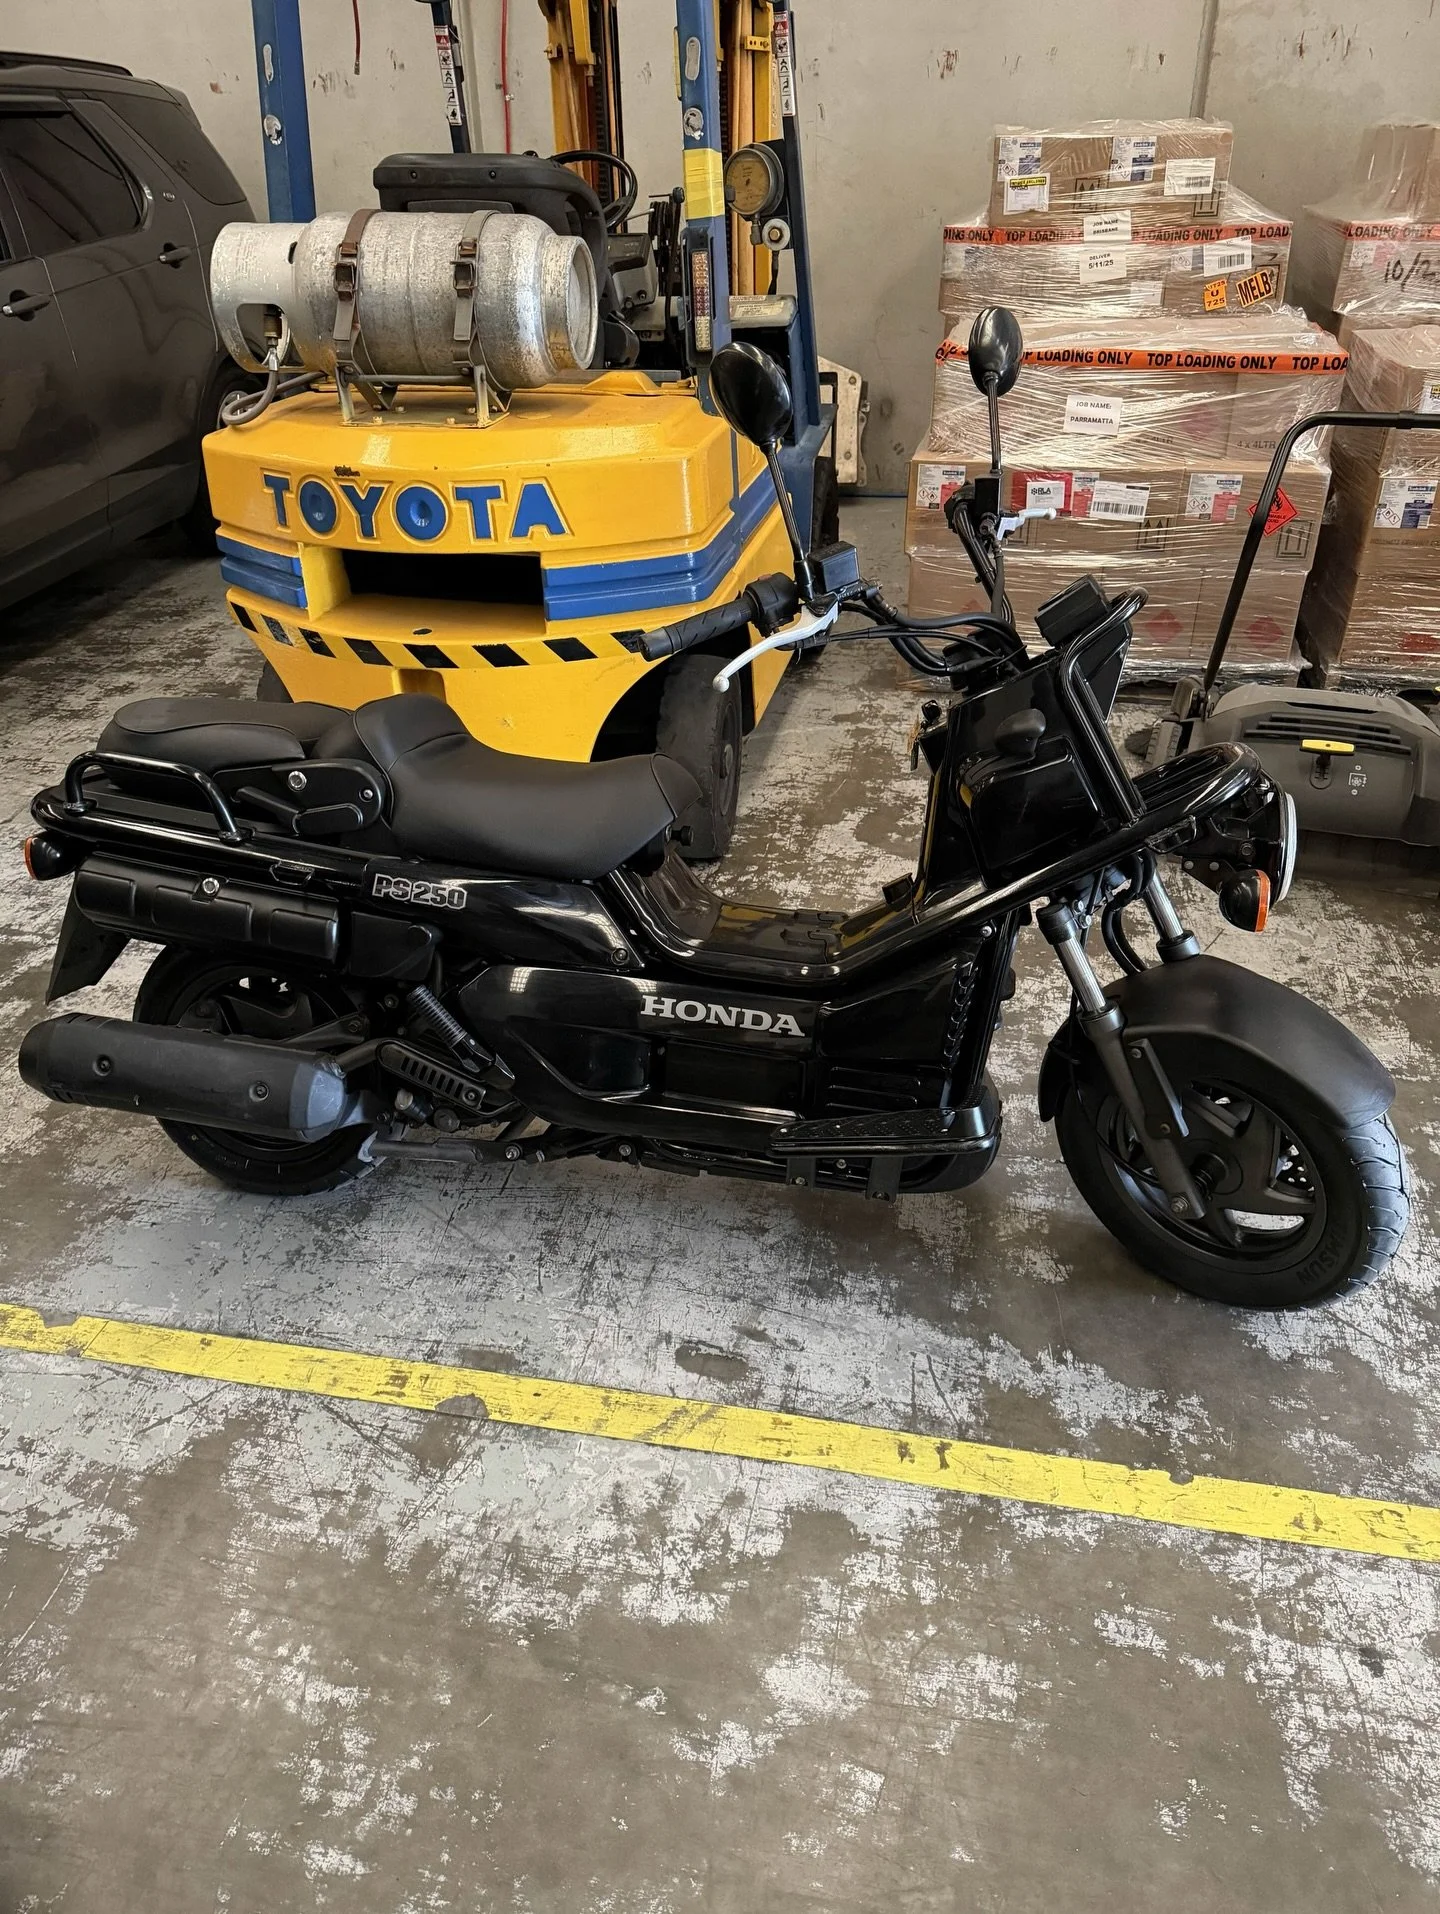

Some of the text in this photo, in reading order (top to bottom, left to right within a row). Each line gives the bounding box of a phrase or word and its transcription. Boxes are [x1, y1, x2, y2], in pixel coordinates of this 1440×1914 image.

[968, 229, 994, 241] ONLY
[1005, 230, 1026, 241] TOP
[1092, 226, 1119, 235] BRISBANE
[1193, 228, 1223, 241] ONLY
[1234, 228, 1258, 238] TOP
[1089, 253, 1111, 261] DELIVER
[1088, 259, 1114, 269] 5/11/25
[1211, 289, 1219, 297] U
[1238, 271, 1272, 306] MELB
[1206, 297, 1225, 307] 725
[1036, 349, 1094, 363] LOADING
[1097, 351, 1133, 365] ONLY
[1147, 352, 1173, 366] TOP
[1176, 354, 1236, 368] LOADING
[1239, 356, 1277, 369] ONLY
[1292, 356, 1319, 370] TOP
[1070, 415, 1114, 425] PARRAMATTA
[263, 471, 568, 542] TOYOTA
[372, 873, 467, 909] PS250
[640, 994, 805, 1037] HONDA
